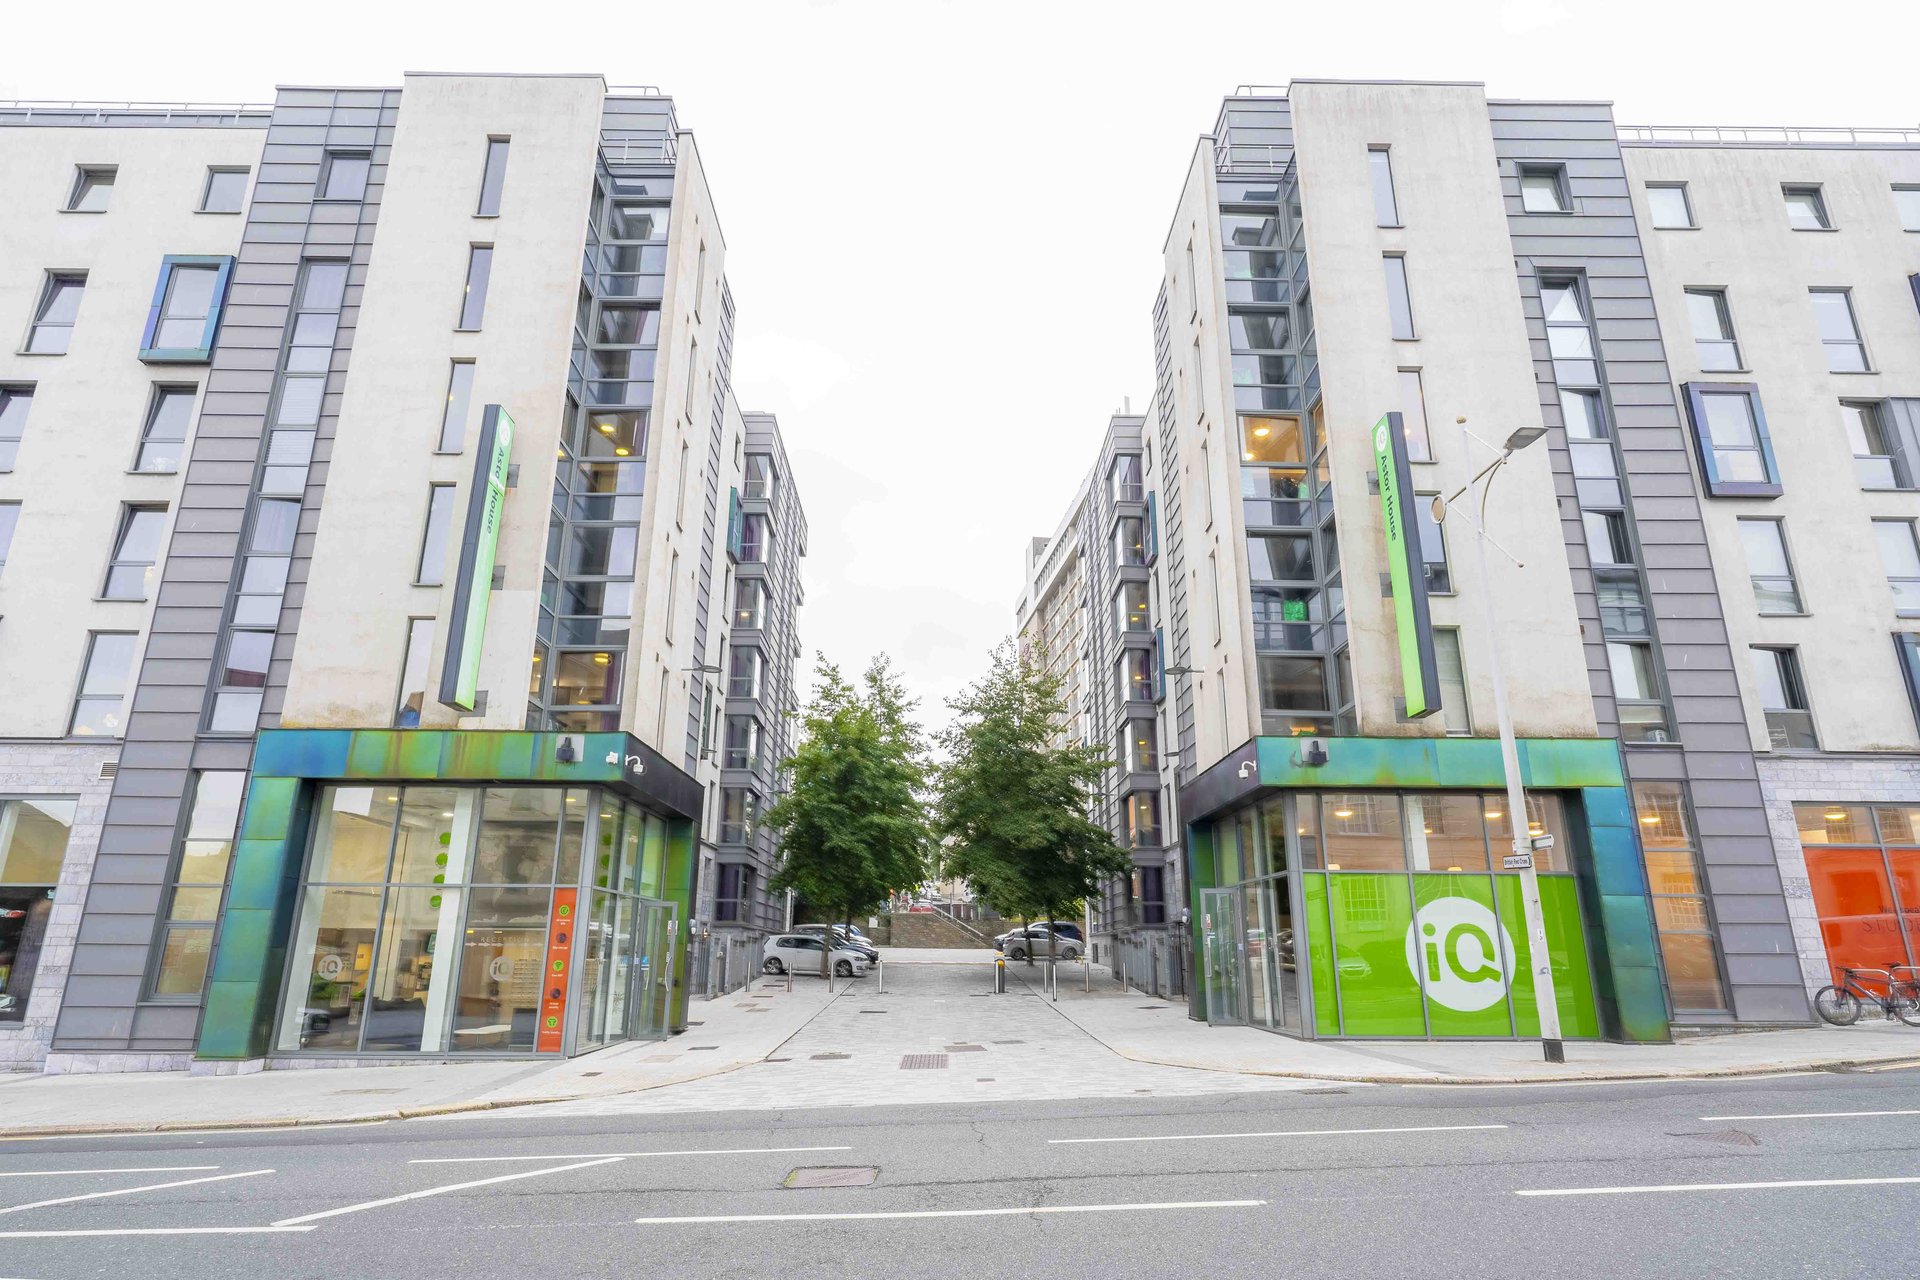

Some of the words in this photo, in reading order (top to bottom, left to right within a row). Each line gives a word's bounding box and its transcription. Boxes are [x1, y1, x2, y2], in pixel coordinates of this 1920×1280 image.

[493, 446, 505, 484] Asto
[486, 489, 499, 534] House
[1381, 455, 1391, 491] Astor
[1386, 495, 1397, 541] House
[321, 960, 339, 974] iQ
[1422, 922, 1502, 983] iQ
